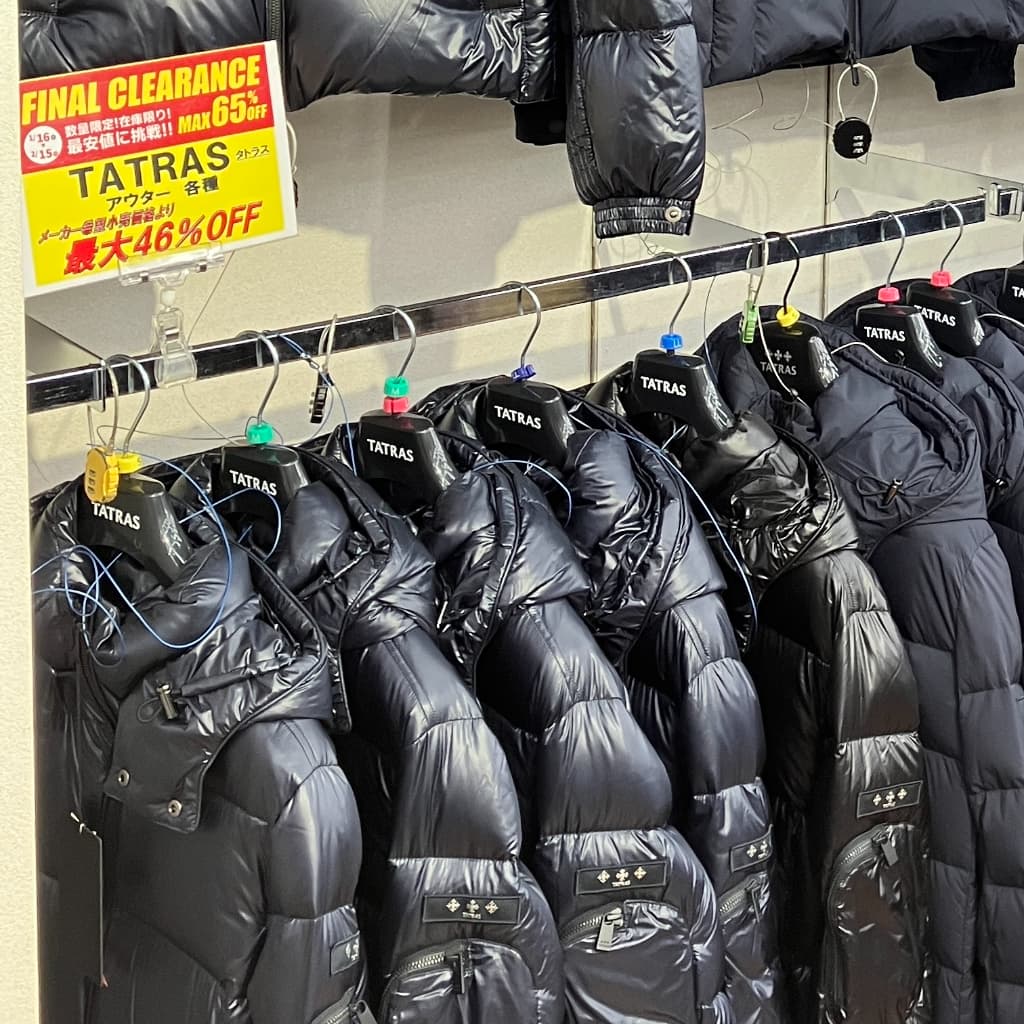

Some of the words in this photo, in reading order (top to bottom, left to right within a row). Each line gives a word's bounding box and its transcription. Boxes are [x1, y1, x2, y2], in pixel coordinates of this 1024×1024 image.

[21, 81, 102, 126] FINAL
[108, 55, 262, 110] CLEARANCE
[236, 144, 271, 161] タトラス
[69, 142, 231, 199] TATRAS
[107, 190, 171, 212] アウター
[184, 175, 220, 197] 各種
[913, 304, 956, 327] TATRAS
[863, 326, 906, 342] TATRAS
[759, 361, 797, 376] TATRAS
[640, 375, 687, 397] TATRAS
[494, 405, 542, 430] TATRAS
[367, 438, 415, 463] TATRAS
[229, 469, 278, 497] TATRAS
[90, 500, 141, 530] TATRAS
